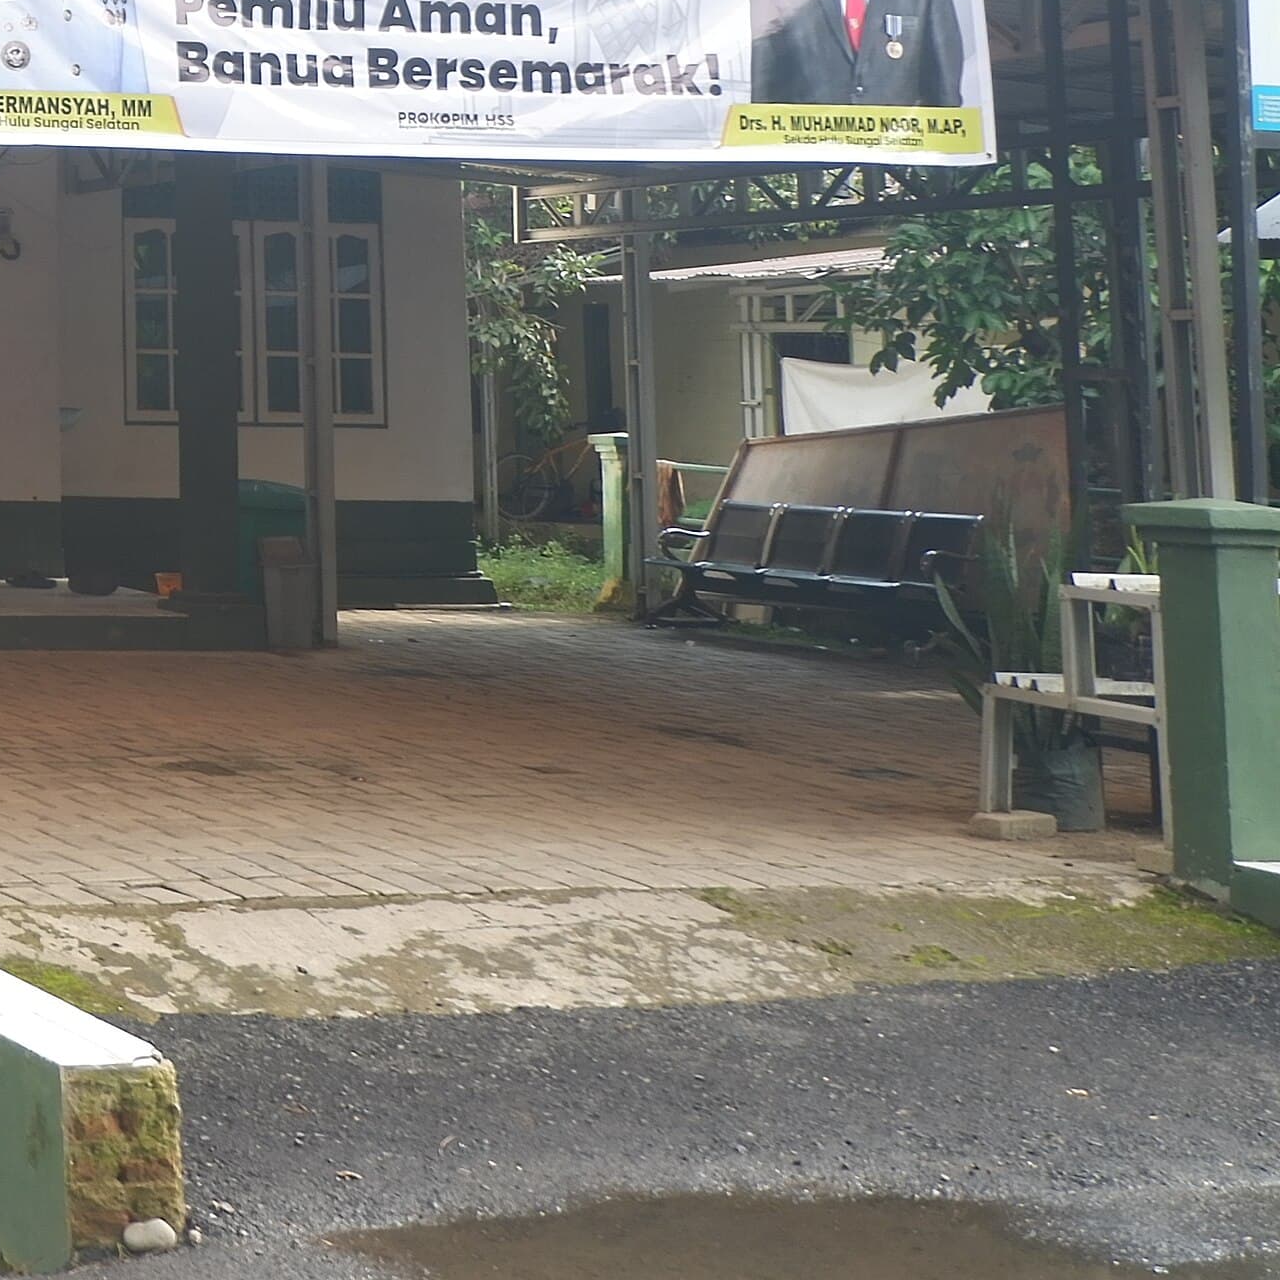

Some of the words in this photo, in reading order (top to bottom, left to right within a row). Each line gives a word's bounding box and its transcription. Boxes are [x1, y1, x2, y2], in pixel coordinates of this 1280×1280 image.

[176, 41, 354, 88] Banua
[367, 47, 721, 97] Bersemarak!
[122, 99, 152, 117] MM
[0, 115, 30, 128] Hulu
[34, 117, 83, 131] Sungai
[86, 119, 140, 131] Selatan
[398, 112, 478, 125] PROKOPIM
[486, 114, 515, 126] HSS
[740, 115, 767, 131] Drs.
[772, 115, 786, 131] H.
[791, 116, 875, 132] MUHAMMAD
[880, 118, 924, 136] NOOR,
